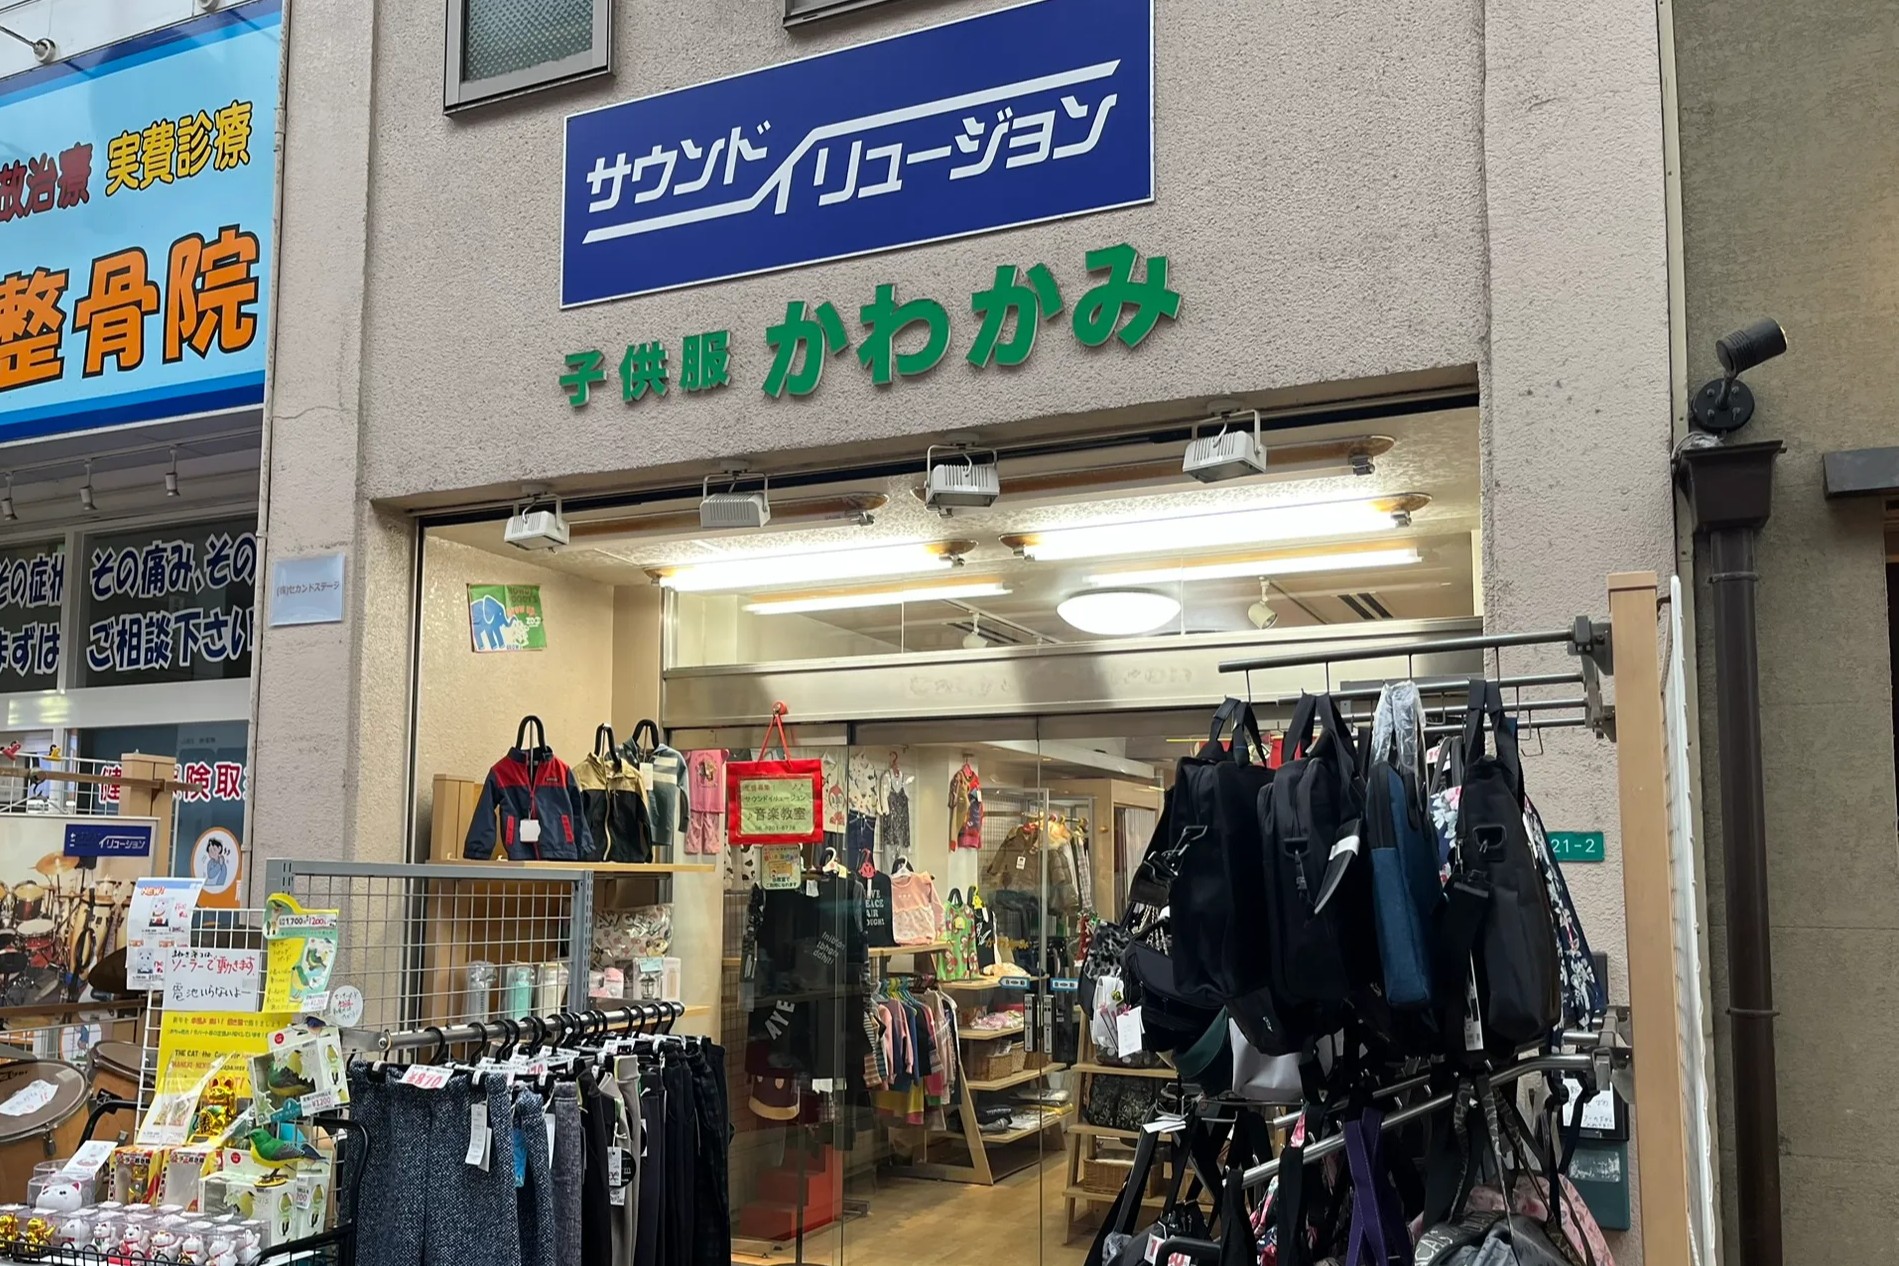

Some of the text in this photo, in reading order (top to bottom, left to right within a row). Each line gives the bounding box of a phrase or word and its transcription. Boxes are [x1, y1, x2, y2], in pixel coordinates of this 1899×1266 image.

[105, 99, 254, 196] 実費診療
[582, 58, 1121, 244] サウンドイリュージョン
[0, 224, 260, 391] 整骨院
[559, 243, 1183, 407] 子供服 かわかみ
[86, 605, 255, 672] ご相談下さい
[755, 806, 806, 821] 音楽教室
[1550, 838, 1596, 853] 21-2
